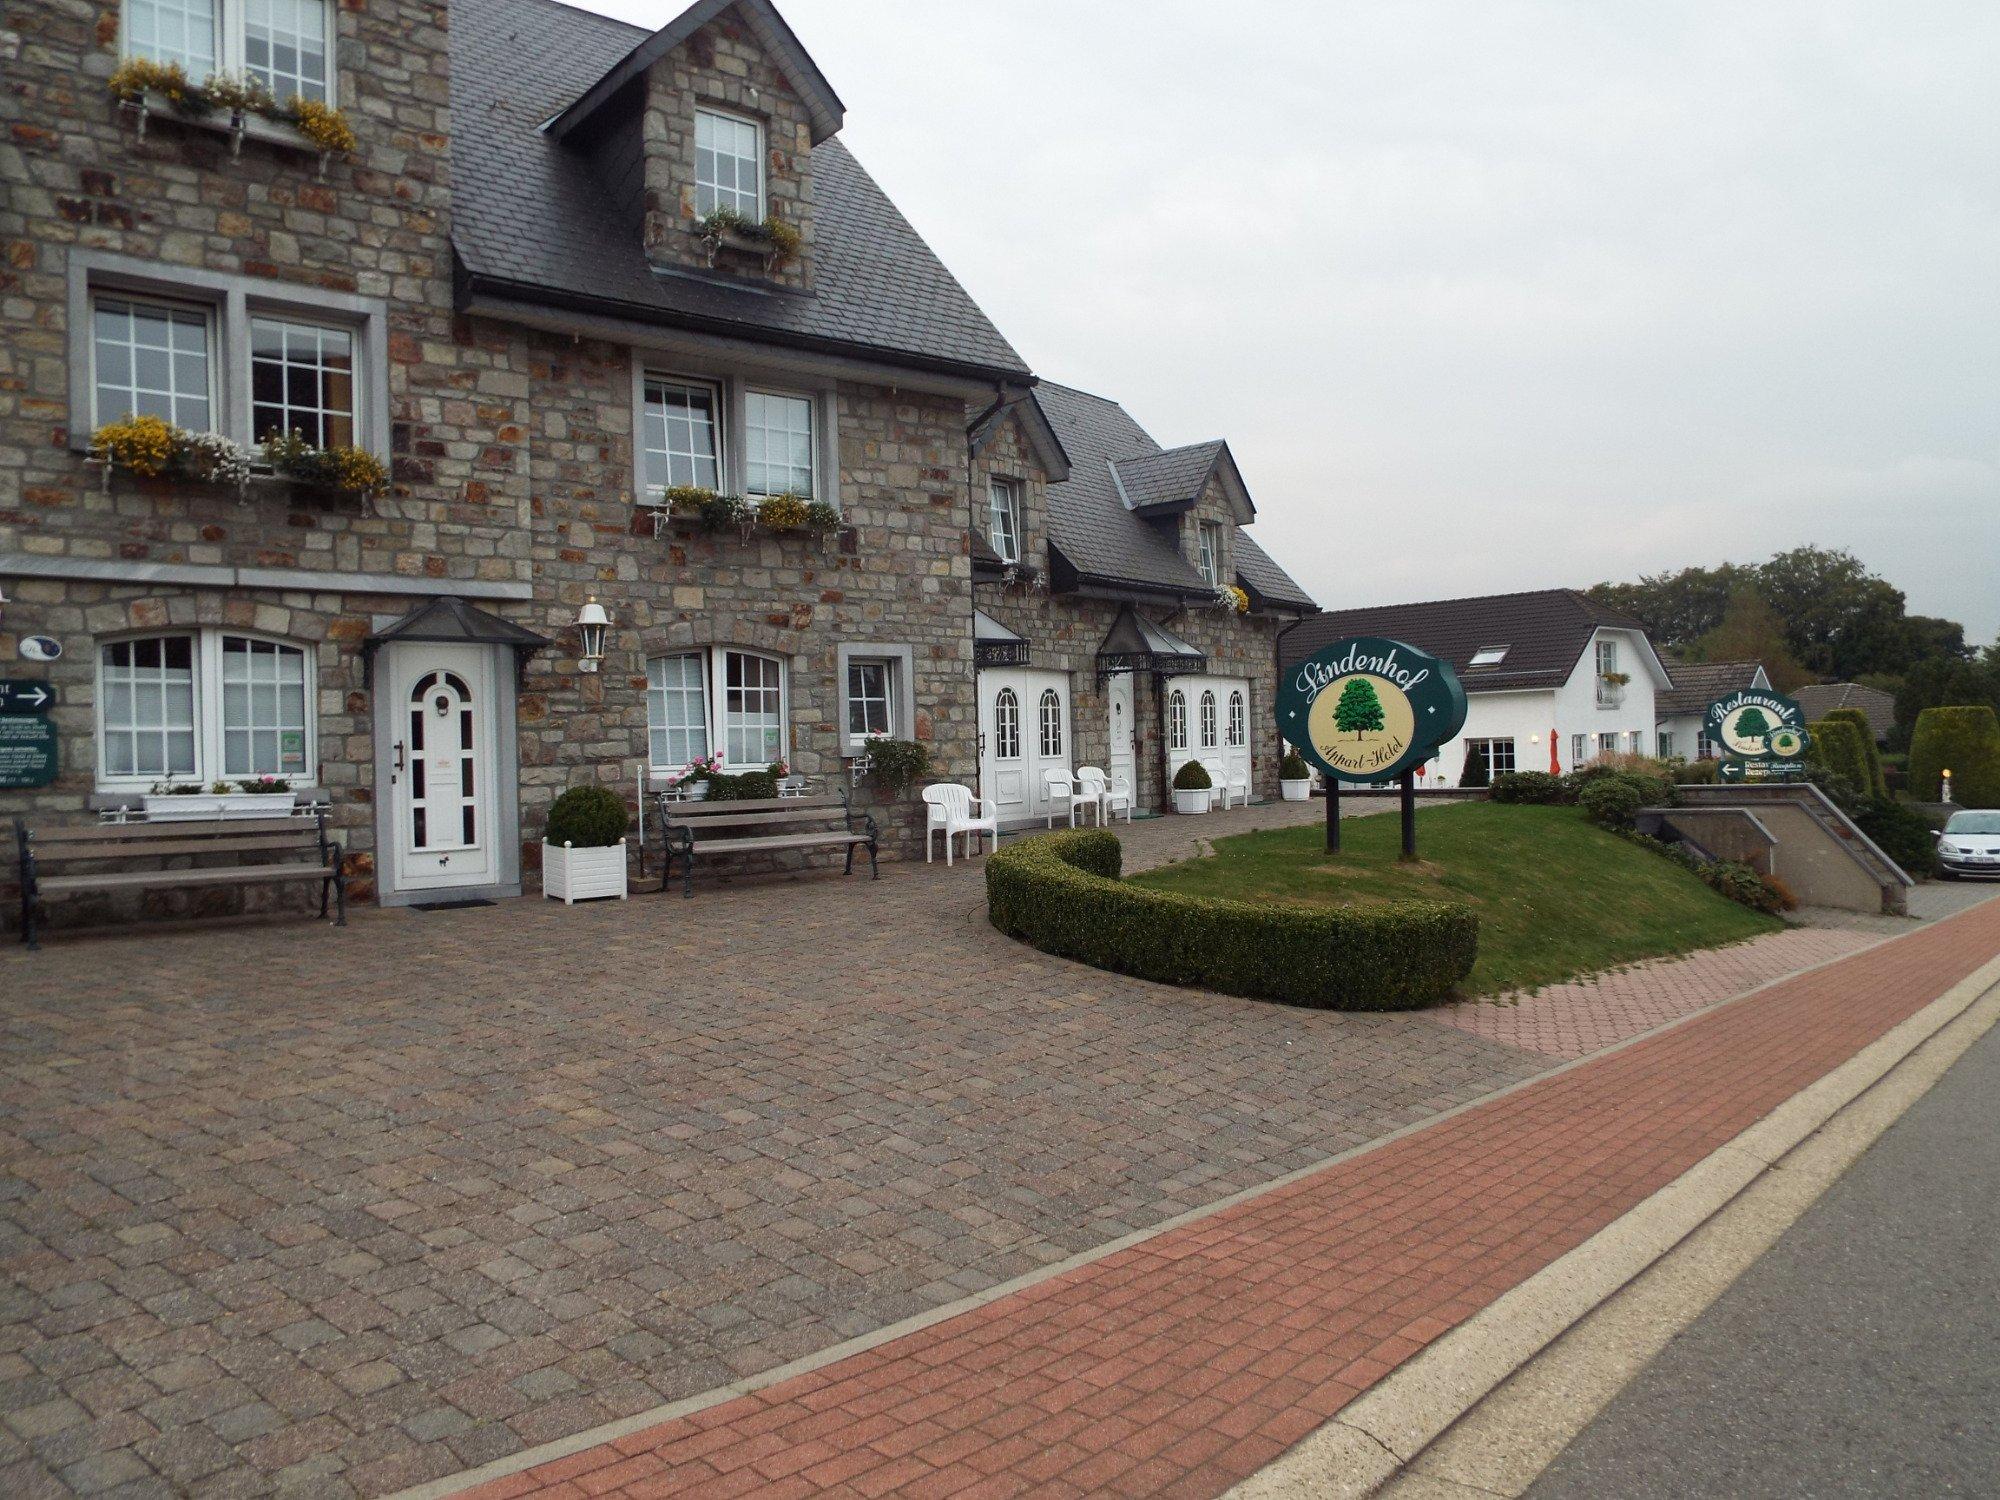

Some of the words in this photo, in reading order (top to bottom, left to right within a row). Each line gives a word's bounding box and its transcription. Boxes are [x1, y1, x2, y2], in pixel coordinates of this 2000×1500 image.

[1296, 642, 1429, 704] Lindenhof
[1711, 691, 1796, 723] Restaurant
[1320, 735, 1403, 769] Appart-Hotel
